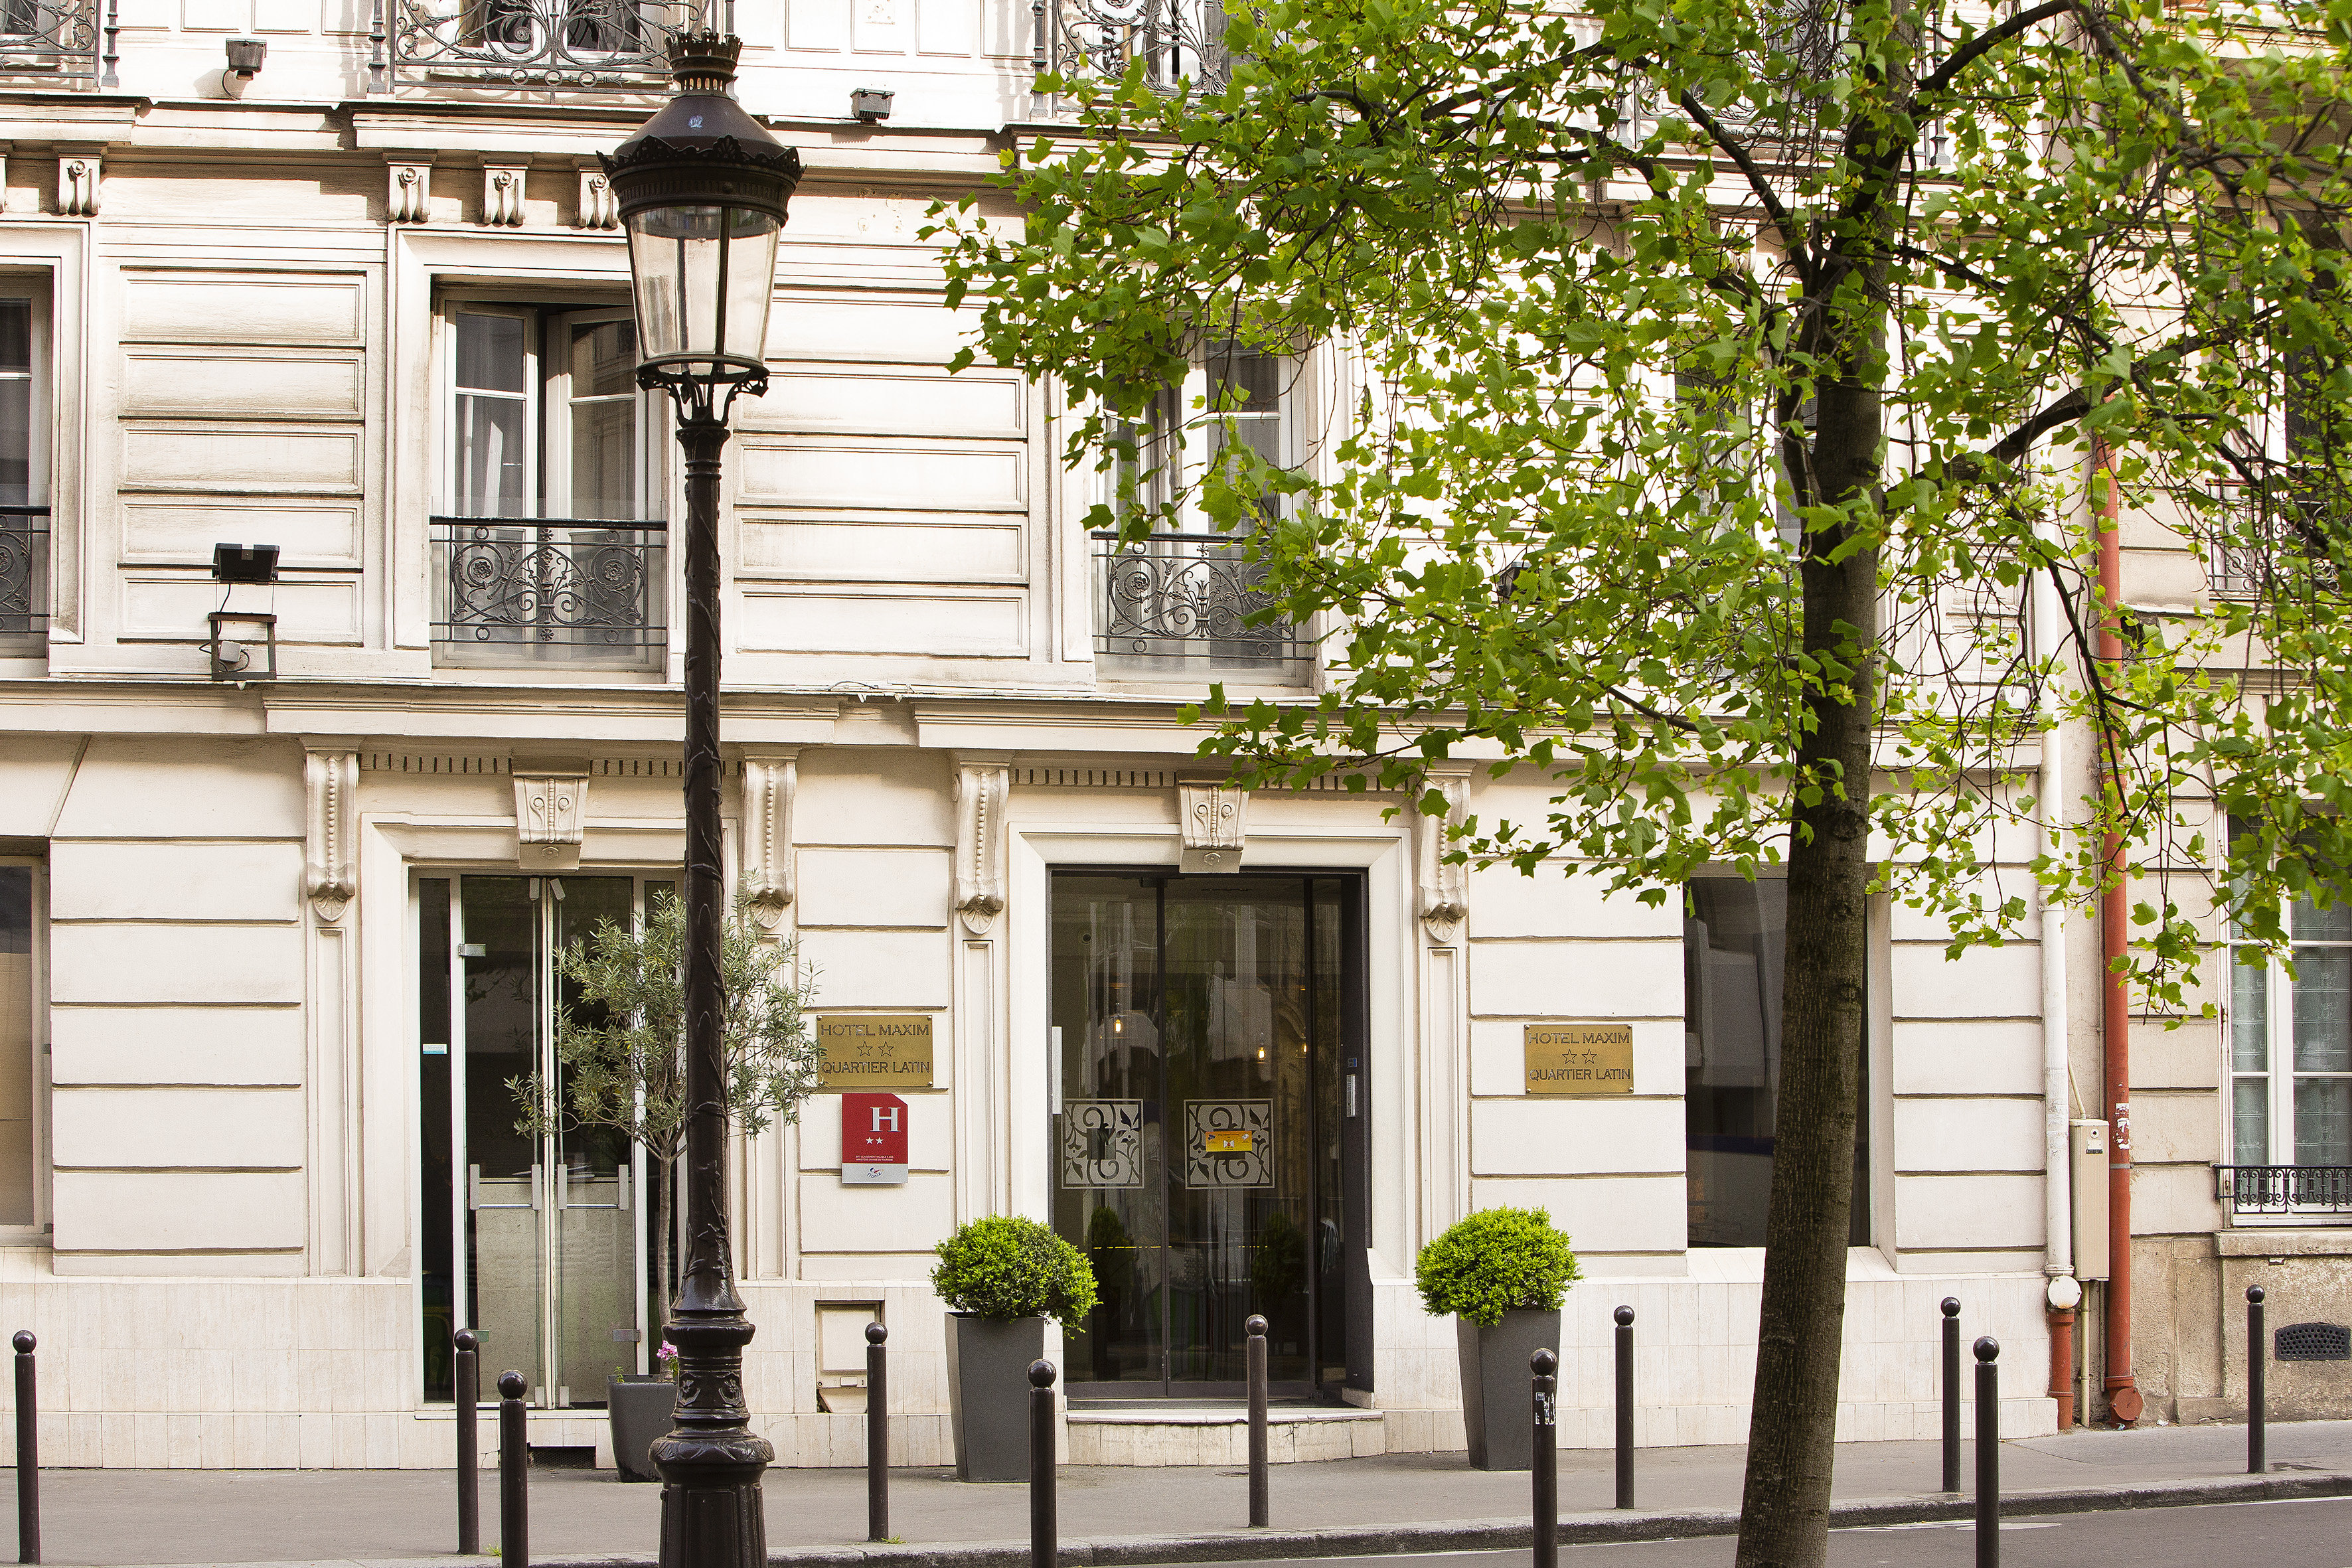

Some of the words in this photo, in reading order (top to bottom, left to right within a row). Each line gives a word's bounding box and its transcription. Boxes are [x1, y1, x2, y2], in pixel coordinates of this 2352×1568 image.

[821, 1024, 876, 1036] HOTEL
[879, 1024, 929, 1036] MAXIM
[1528, 1032, 1580, 1044] HOTEL
[1583, 1032, 1630, 1044] MAXIM
[821, 1061, 889, 1075] QUARTIER
[893, 1061, 930, 1073] LATIN
[1529, 1068, 1592, 1081] QUARTIER
[1596, 1068, 1630, 1080] LATIN
[870, 1107, 901, 1132] H
